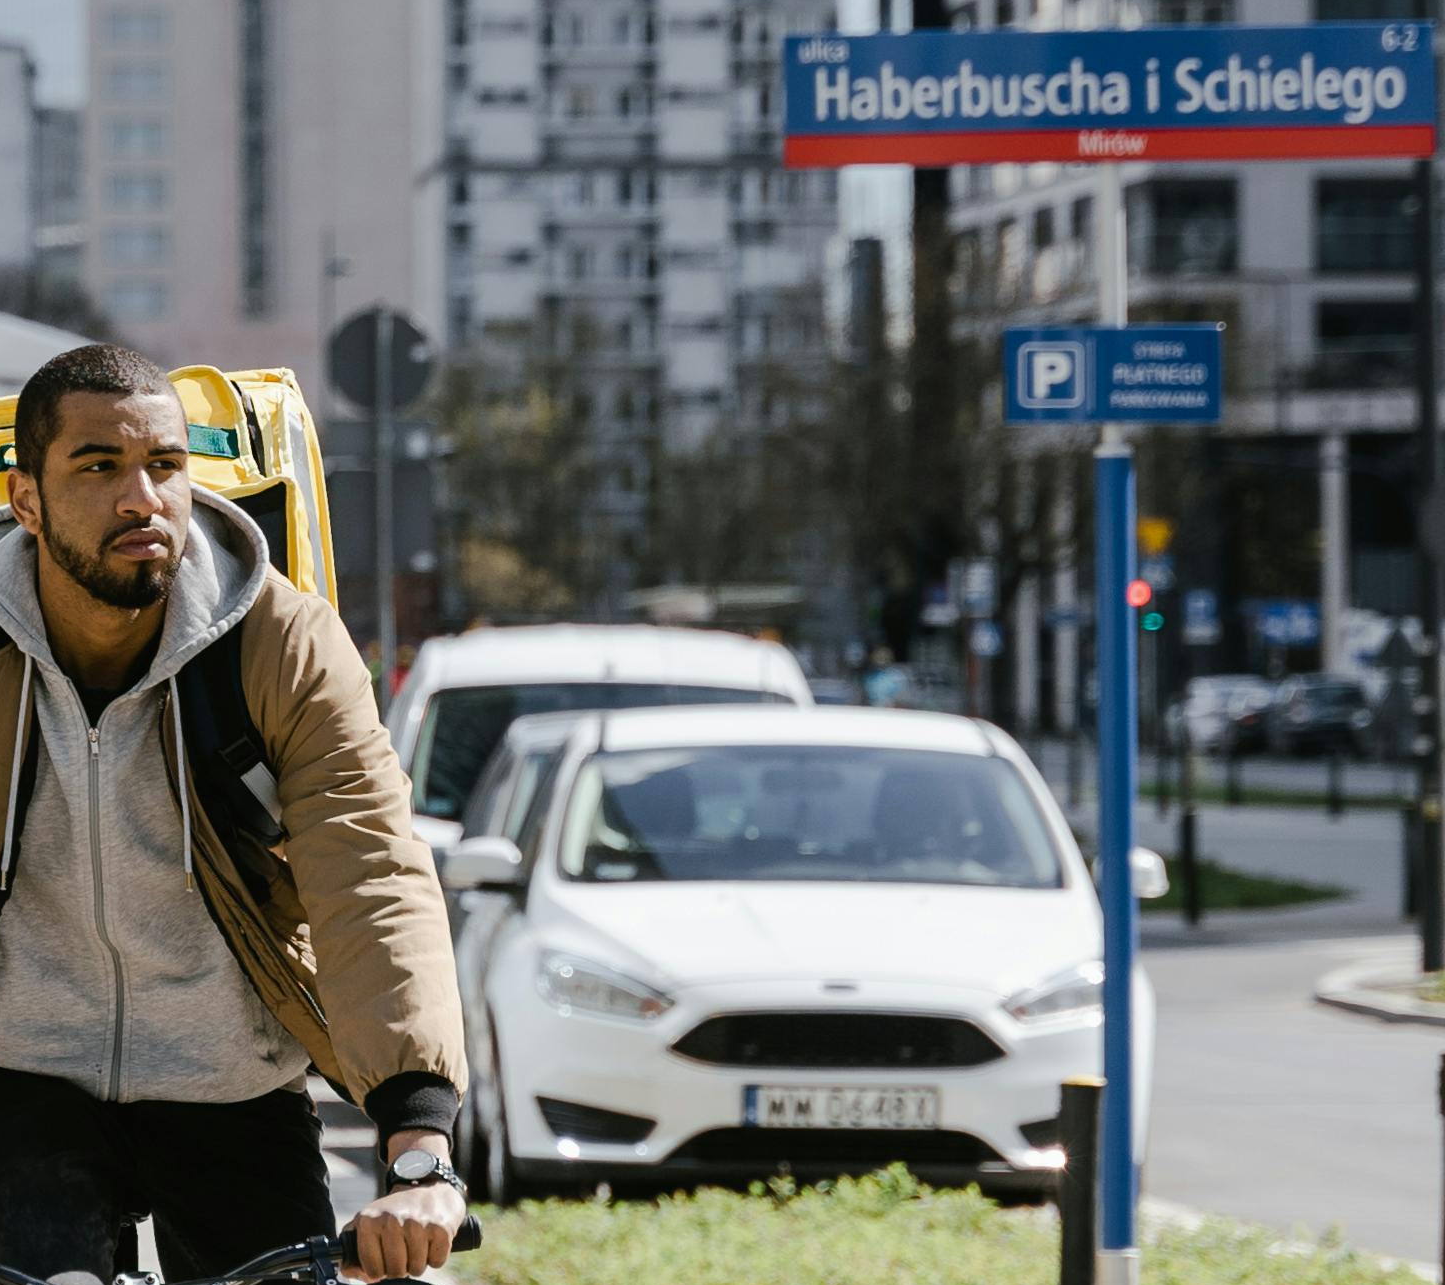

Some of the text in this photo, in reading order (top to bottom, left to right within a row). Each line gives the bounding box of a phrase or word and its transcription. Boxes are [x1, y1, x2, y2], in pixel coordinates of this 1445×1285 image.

[798, 37, 850, 63] ulica
[814, 52, 1407, 124] Haberbuscha i Schielego
[1078, 129, 1149, 156] Mirów
[1032, 352, 1072, 399] P
